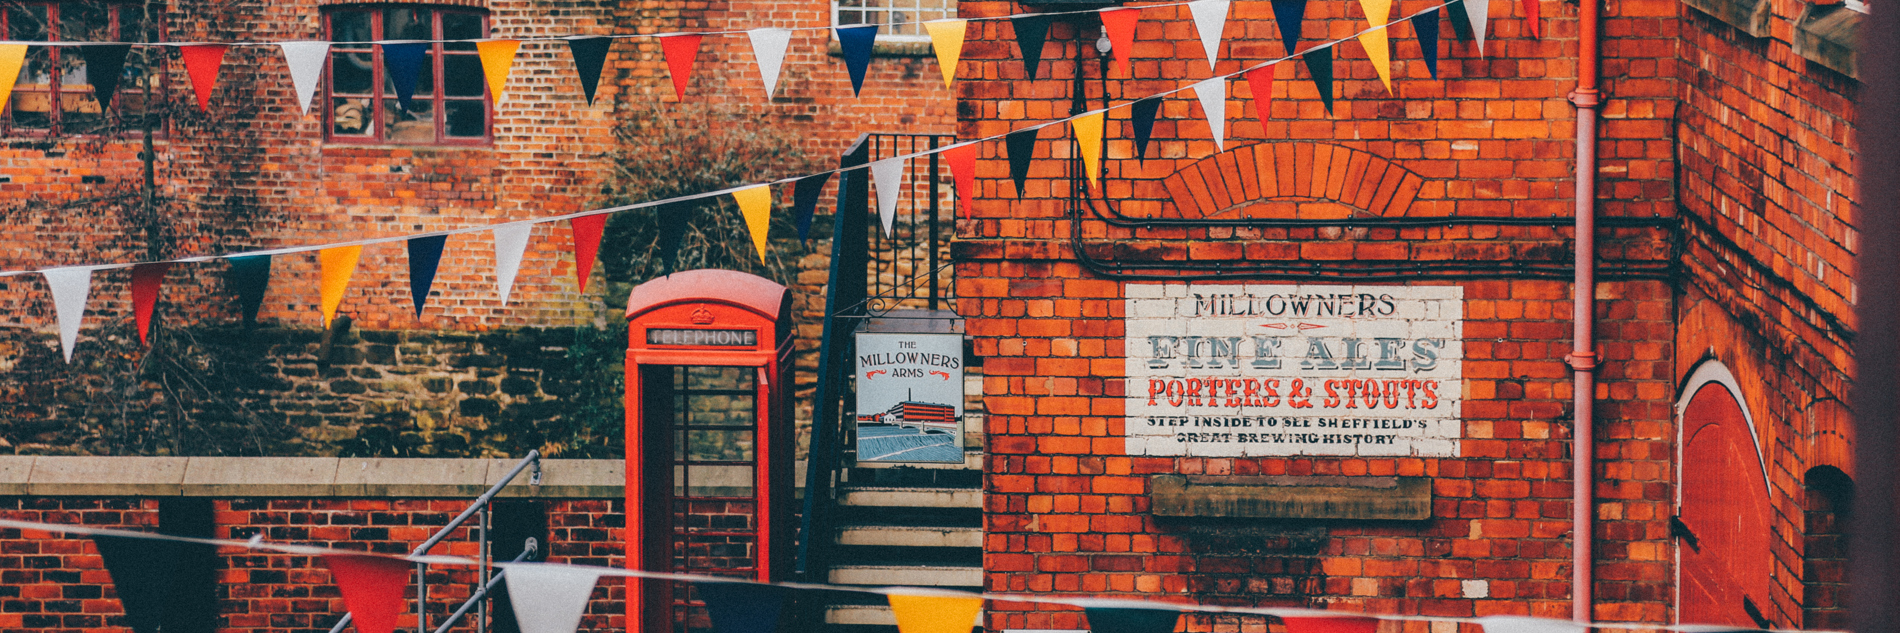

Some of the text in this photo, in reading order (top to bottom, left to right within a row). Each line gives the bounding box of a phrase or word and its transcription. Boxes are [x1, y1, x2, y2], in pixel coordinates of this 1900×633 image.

[1193, 293, 1396, 317] MILLOWNERS
[652, 329, 753, 345] TELEPHONE
[898, 341, 917, 349] THE
[859, 352, 960, 369] MILLOWNERS
[1147, 336, 1446, 373] FINE ALES
[892, 368, 924, 378] ARMS
[1147, 377, 1440, 409] PORTERS & STOUTS
[1147, 416, 1428, 429] STEP INSIDE TO SEE SHEFFIELD'S
[1177, 432, 1396, 444] GREAT BREWING HISTORY
